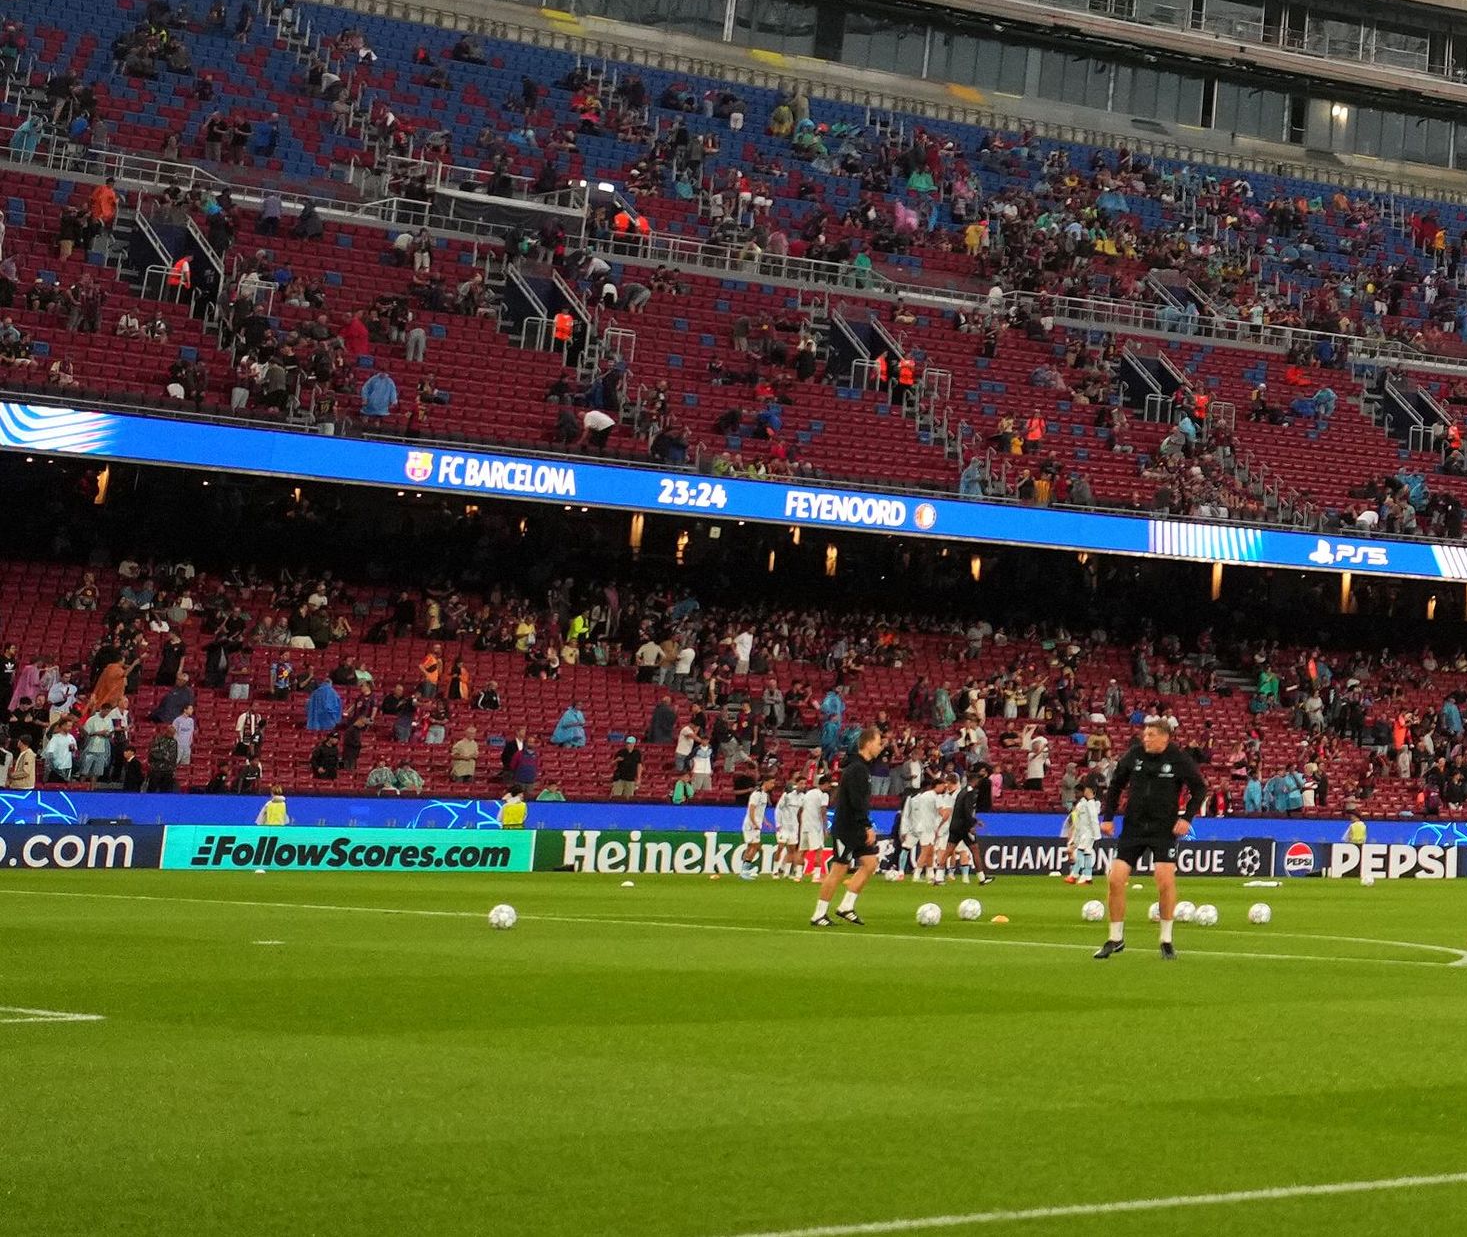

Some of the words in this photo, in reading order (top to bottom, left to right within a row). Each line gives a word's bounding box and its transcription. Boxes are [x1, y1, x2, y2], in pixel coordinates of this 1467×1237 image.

[438, 455, 464, 484] FC
[464, 458, 576, 496] BARCELONA
[657, 479, 728, 509] 23:24
[784, 490, 906, 526] FEYENOORD
[1336, 544, 1388, 565] PS5
[0, 834, 134, 868] .com
[212, 836, 511, 868] FollowScores.com
[1331, 843, 1458, 879] PEPSI
